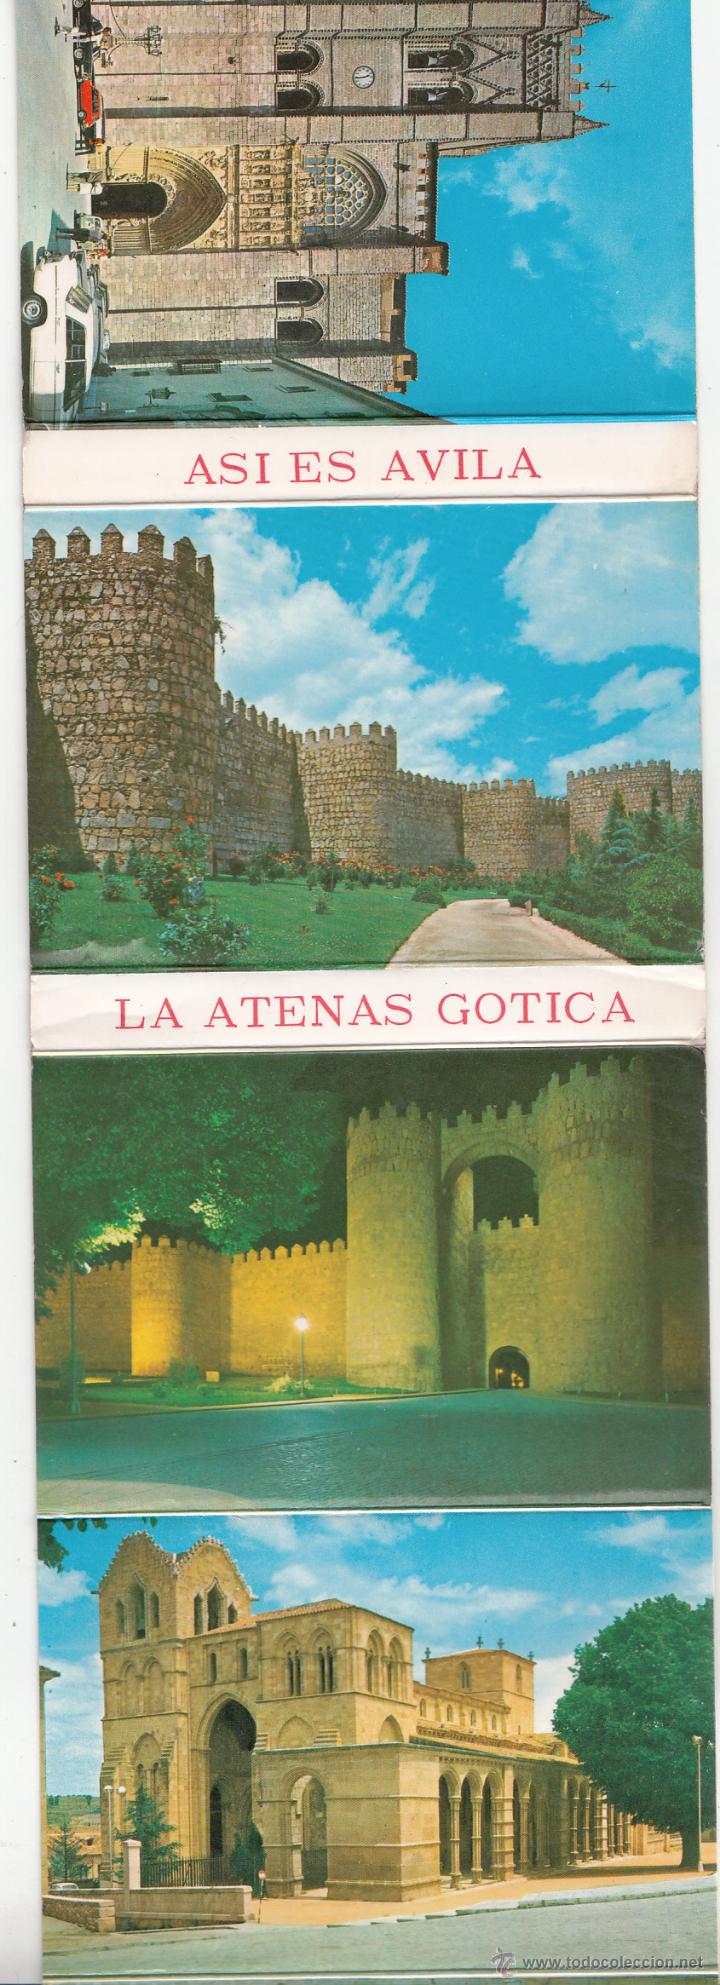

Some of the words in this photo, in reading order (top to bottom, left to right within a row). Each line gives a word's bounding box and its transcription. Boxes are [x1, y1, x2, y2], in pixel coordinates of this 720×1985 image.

[183, 452, 271, 485] ASI
[288, 450, 357, 484] ES
[381, 447, 543, 482] AVILA
[115, 997, 183, 1031] LA
[205, 993, 414, 1029] ATENAS
[437, 991, 636, 1025] GOTICA
